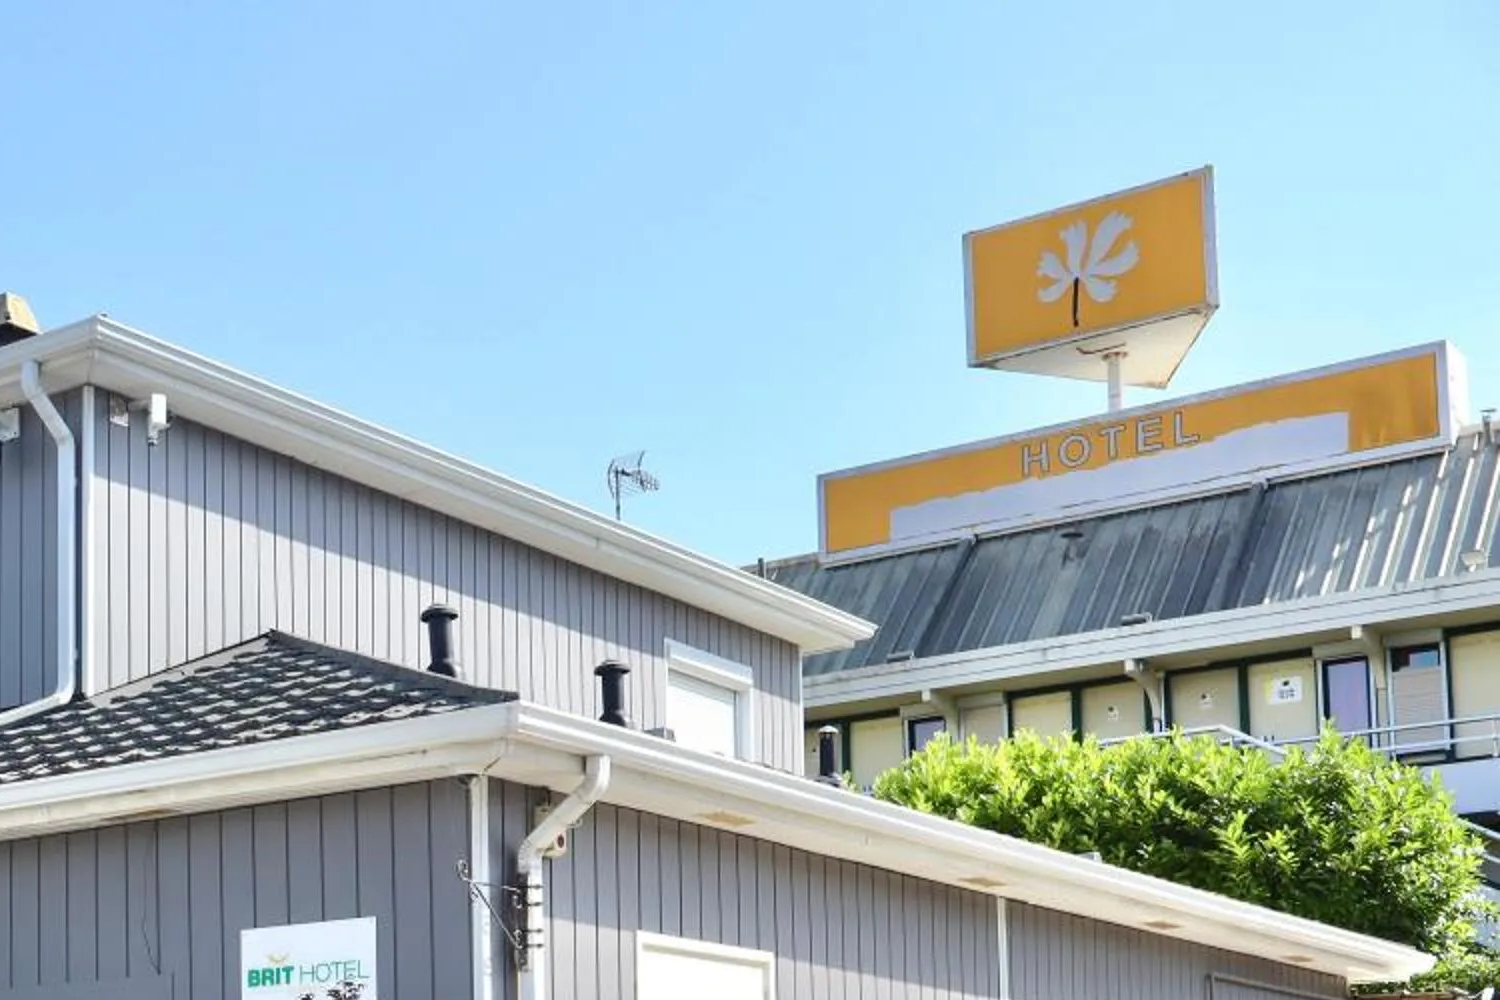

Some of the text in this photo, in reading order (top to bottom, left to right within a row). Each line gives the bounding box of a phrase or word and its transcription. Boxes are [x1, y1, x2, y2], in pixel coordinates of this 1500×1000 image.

[1022, 410, 1200, 479] HOTEL
[247, 959, 370, 988] BRIT HOTEL
